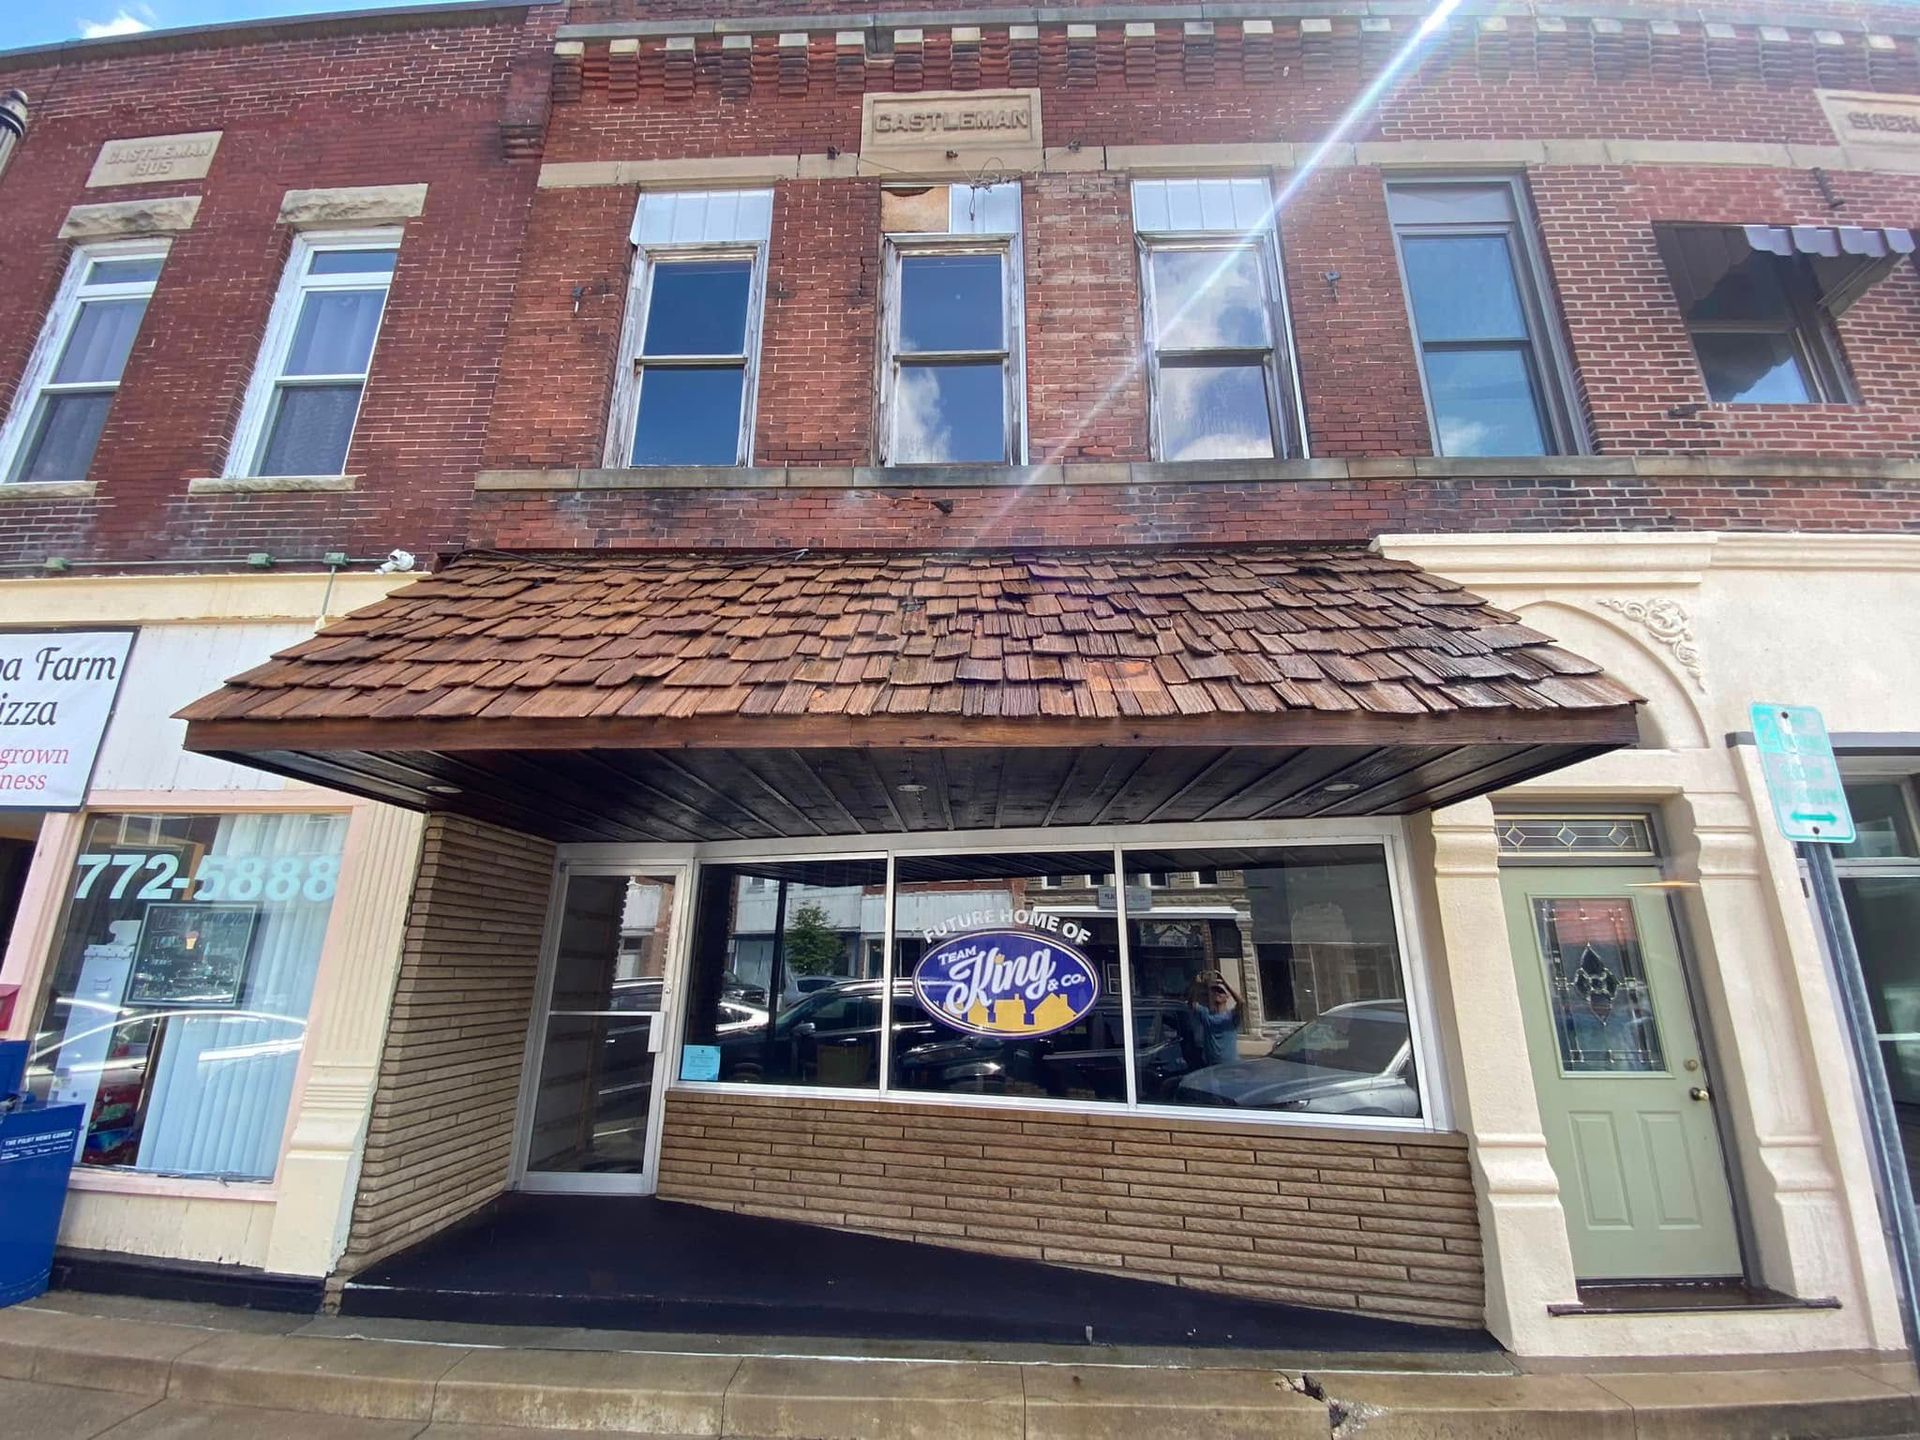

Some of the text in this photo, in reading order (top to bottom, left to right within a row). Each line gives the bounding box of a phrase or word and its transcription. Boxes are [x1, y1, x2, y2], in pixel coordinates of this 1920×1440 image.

[875, 109, 1029, 134] CASTLEMAN
[105, 141, 214, 165] CASTLEMAN
[35, 646, 117, 681] Farm
[74, 853, 342, 901] 772-5888
[922, 908, 1092, 946] FUTURE HOME OF
[937, 945, 977, 966] TEAM
[945, 946, 1057, 1015] King
[1047, 978, 1059, 992] &
[5, 1139, 17, 1147] THE
[17, 1136, 35, 1146] PILOT
[35, 1134, 52, 1142] NEWS
[52, 1131, 73, 1139] GROUP
